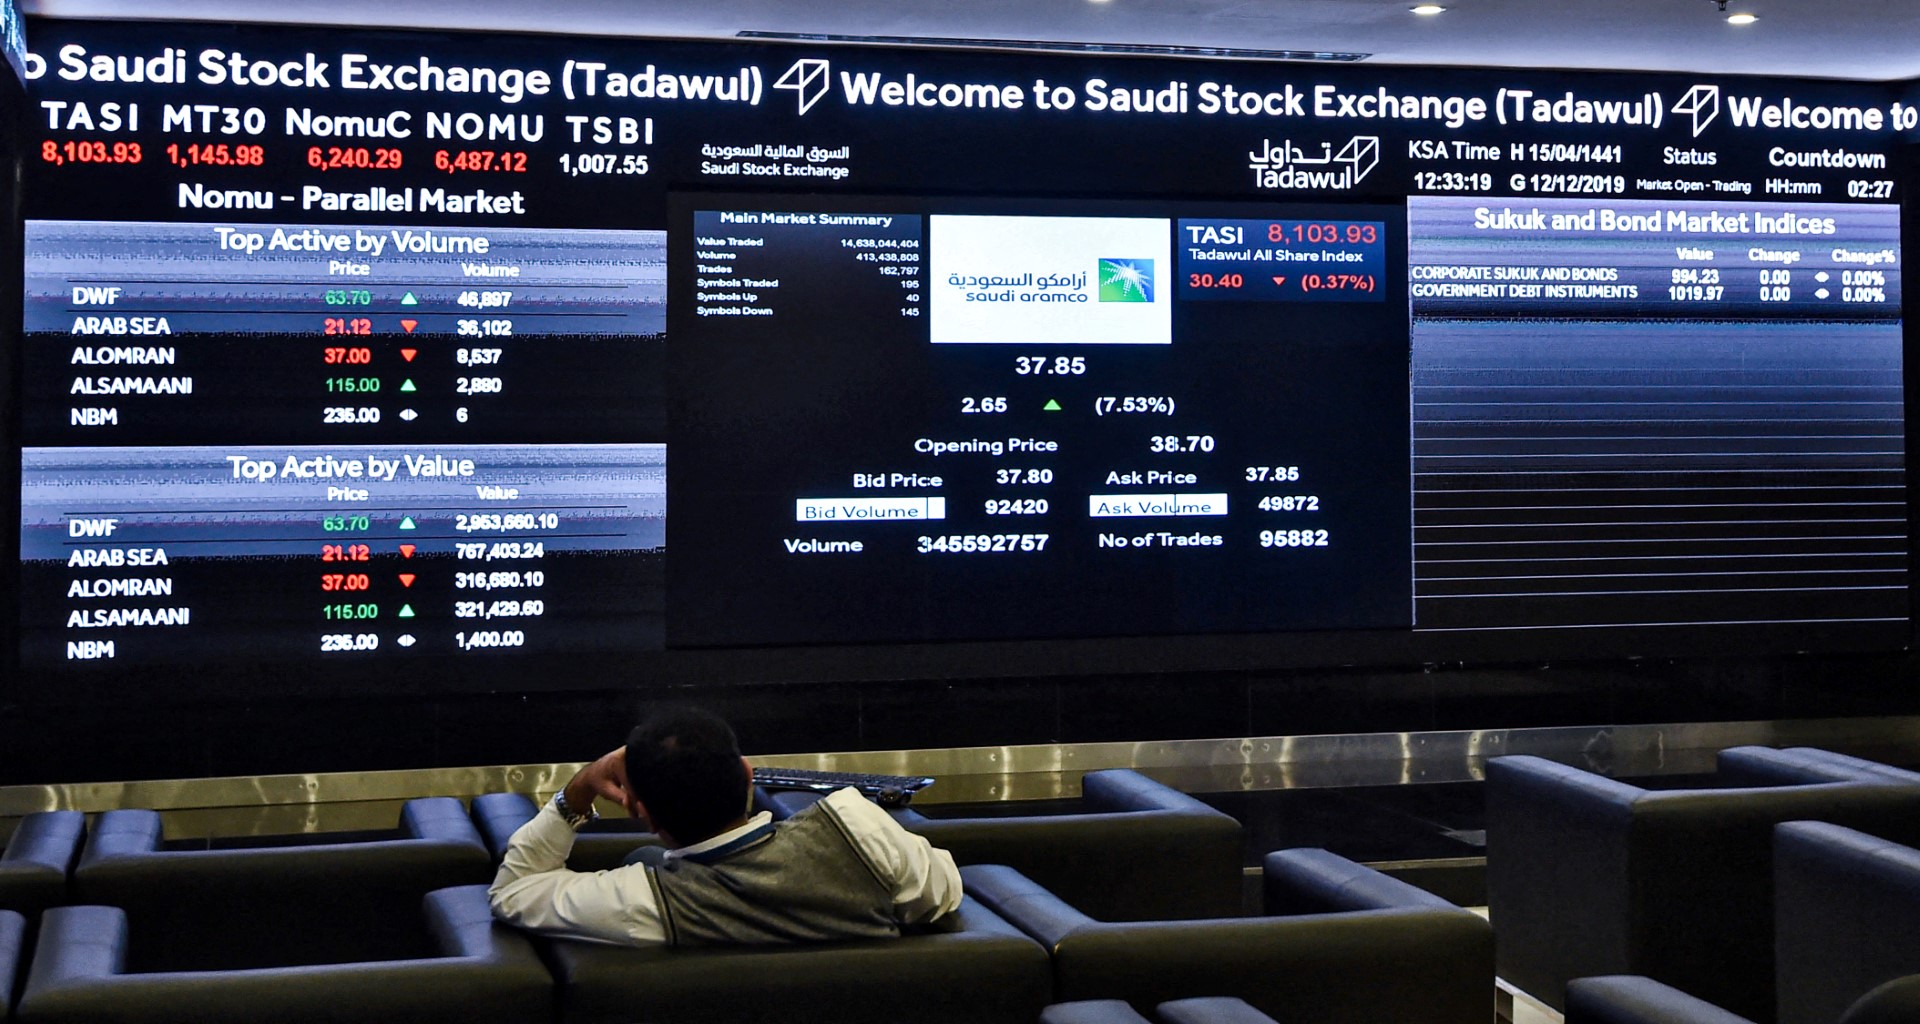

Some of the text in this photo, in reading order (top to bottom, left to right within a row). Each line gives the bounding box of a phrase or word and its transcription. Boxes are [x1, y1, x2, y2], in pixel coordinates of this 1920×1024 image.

[57, 44, 1918, 131] Saudi Stock Exchange (Tadawul) Welcome to Saudi Stock Exchange (Tadawul) Welcome to
[40, 100, 138, 132] TASI
[162, 104, 266, 135] MT30
[285, 107, 412, 139] NomuC
[426, 111, 544, 143] NOMU
[565, 115, 653, 145] TSBI
[41, 139, 143, 166] 8,103.93
[166, 143, 265, 169] 1,145.98
[307, 146, 403, 172] 6,240.29
[701, 143, 850, 162] السوق المالية السعودية
[1408, 140, 1501, 161] KSA Time
[1510, 142, 1621, 164] H 15/04/1441
[1663, 146, 1717, 166] Status
[1768, 146, 1886, 169] Countdown
[434, 149, 528, 175] 6,487.12
[559, 153, 649, 177] 1,007.55
[701, 160, 850, 180] Saudi Stock Exchange
[1248, 161, 1352, 190] Tadawul
[1414, 171, 1492, 191] 12:33:19
[1509, 173, 1625, 194] G 12/12/2019
[1636, 178, 1752, 195] Market Open Trading
[1765, 178, 1822, 195] HH:mm
[1847, 179, 1894, 199] 02:27
[178, 182, 526, 215] Nomu Parallel Market
[720, 211, 893, 228] Main Market Summary
[1474, 207, 1836, 235] Sukuk and Bond Market Indices
[214, 228, 490, 257] Top Active by Volume
[696, 237, 764, 247] Value Traded
[840, 238, 919, 249] 14,638,044,404
[1185, 223, 1377, 245] TASI 8,103.93
[696, 250, 737, 260] Volume
[1188, 248, 1364, 262] Tadawul All Share Index
[1676, 247, 1714, 261] Value
[1748, 248, 1801, 265] Change
[329, 260, 371, 276] Price
[461, 262, 520, 277] Volume
[696, 264, 733, 274] Trades
[879, 266, 920, 276] 162,797
[1411, 266, 1618, 281] CORPORATE SUKUK AND BONDS
[1671, 268, 1720, 284] 994.23
[742, 278, 779, 288] Traded
[900, 279, 920, 289] 195
[948, 271, 1087, 291] أرامكو السعودية
[1189, 273, 1375, 293] 30.40 (0.37%)
[1409, 282, 1639, 299] GOVERNMENT DEBT INSTRUMENTS
[72, 286, 122, 305] DWF
[324, 289, 372, 306] 63.70
[742, 292, 758, 303] Up
[905, 293, 920, 302] 40
[966, 289, 1088, 303] saudi aramco
[1668, 285, 1725, 301] 1019.97
[742, 306, 774, 316] Down
[900, 307, 920, 317] 145
[71, 316, 172, 335] ARAB SEA
[324, 317, 372, 336] 21.12
[456, 319, 513, 339] 36,102
[70, 346, 175, 365] ALOMRAN
[324, 347, 371, 365] 37.00
[1015, 356, 1086, 375] 37.85
[70, 376, 193, 395] ALSAMAANI
[326, 377, 381, 393] 115.00
[456, 407, 469, 423] 6
[961, 396, 1175, 416] 2.65 (7.53%)
[71, 407, 118, 426] NBM
[914, 435, 1215, 457] Opening Price 38.70
[227, 454, 475, 482] Top Active by Value
[996, 468, 1053, 484] 37.80
[1105, 470, 1197, 485] Ask Price
[1245, 466, 1300, 482] 37.85
[853, 473, 943, 488] Bid Price
[327, 486, 369, 501] Price
[475, 485, 519, 500] Value
[805, 505, 919, 519] Bid Volume
[984, 498, 1049, 515] 92420
[1097, 500, 1214, 516] Ask Volume
[1258, 495, 1319, 511] 49872
[69, 518, 119, 538] DWF
[323, 515, 370, 532] 63.70
[783, 538, 864, 553] Volume
[917, 533, 1049, 553] 345592757
[1098, 531, 1223, 548] No of Trades
[1259, 529, 1329, 548] 95882
[67, 548, 169, 568] ARAB SEA
[321, 544, 370, 563] 21.12
[455, 541, 545, 562] 767,403.24
[67, 577, 172, 598] ALOMRAN
[321, 573, 370, 591] 37.00
[66, 607, 190, 628] ALSAMAANI
[324, 603, 379, 620] 115.00
[67, 640, 115, 660] NBM
[455, 630, 525, 651] 1,400.00
